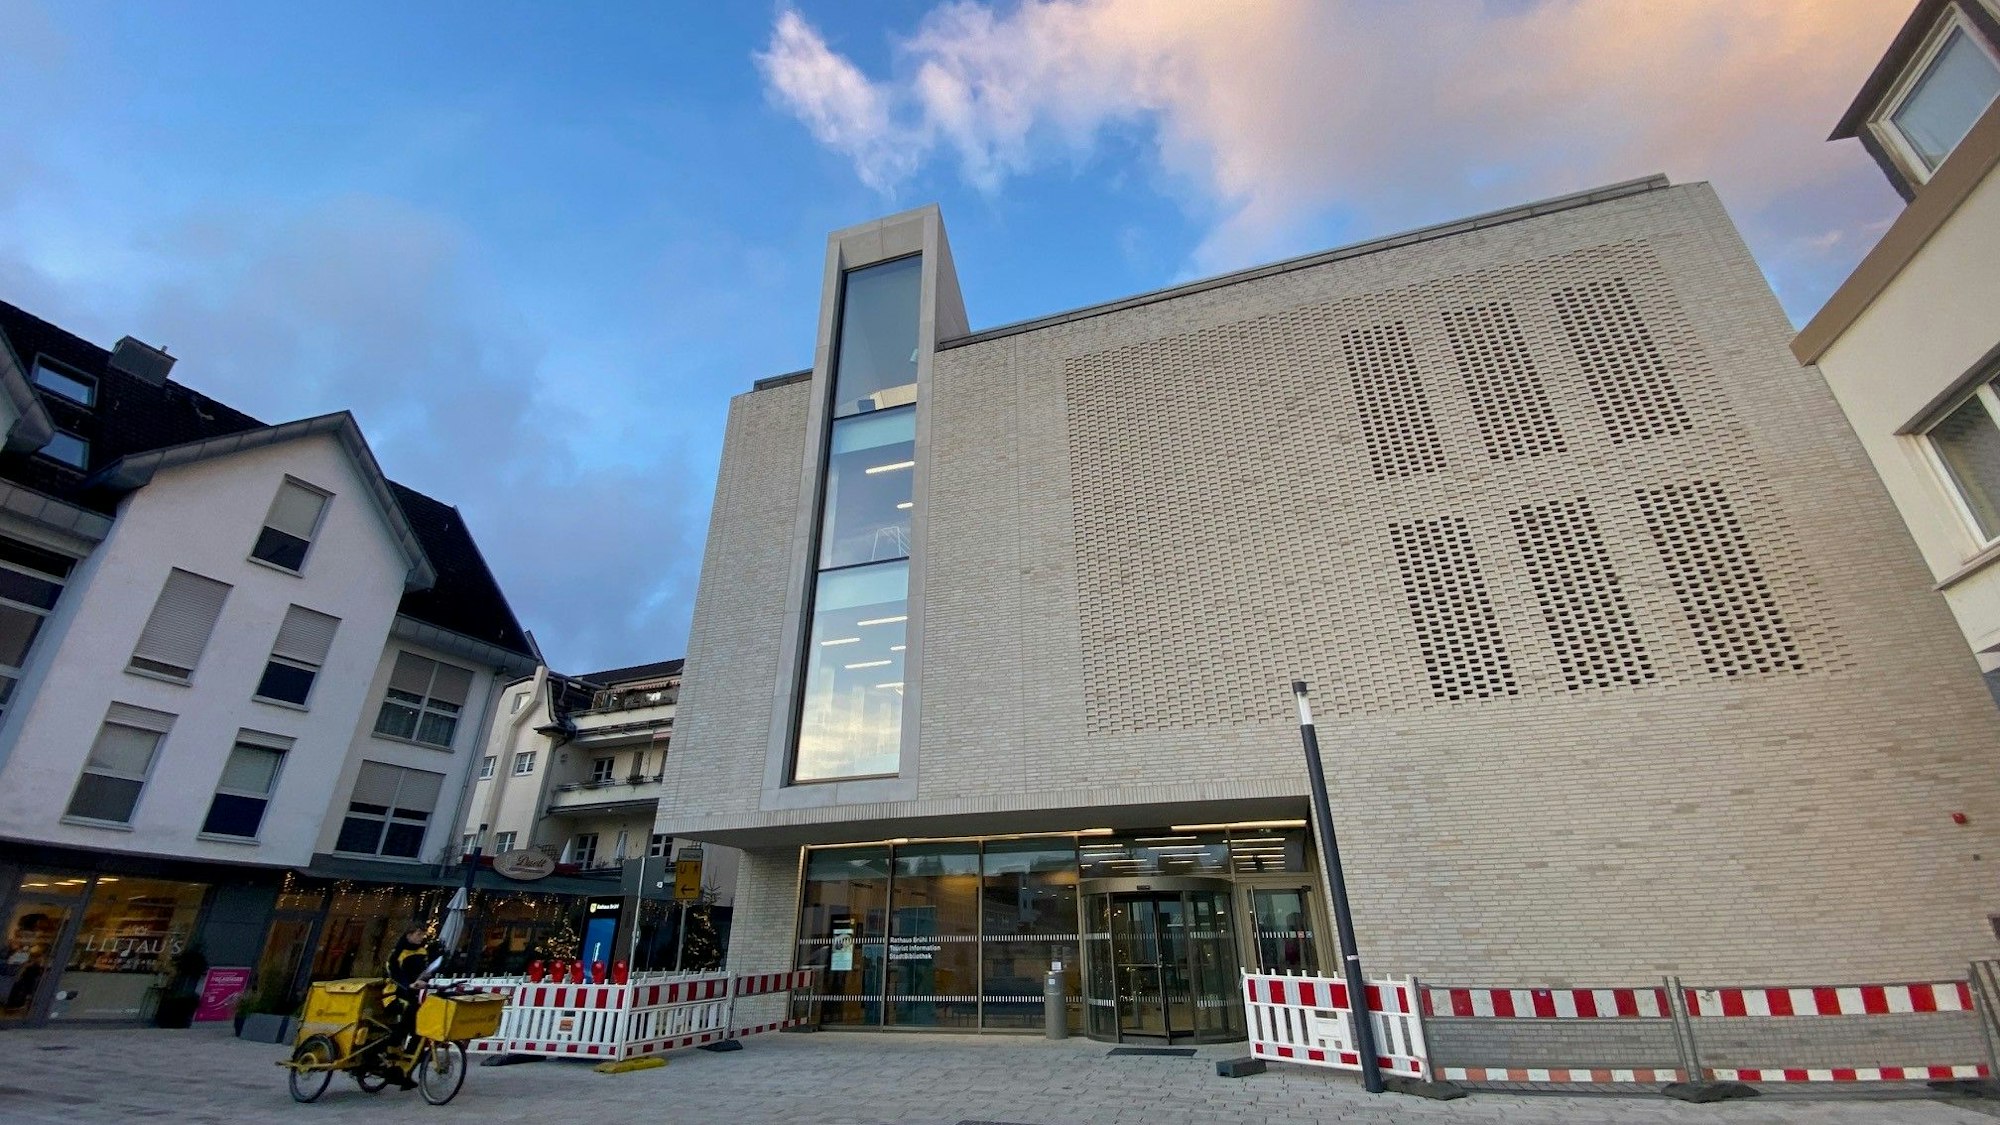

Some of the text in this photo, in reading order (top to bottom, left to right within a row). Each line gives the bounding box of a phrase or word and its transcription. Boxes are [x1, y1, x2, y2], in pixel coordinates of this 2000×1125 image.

[890, 936, 912, 944] Rathaus
[889, 944, 942, 952] Tourist Information
